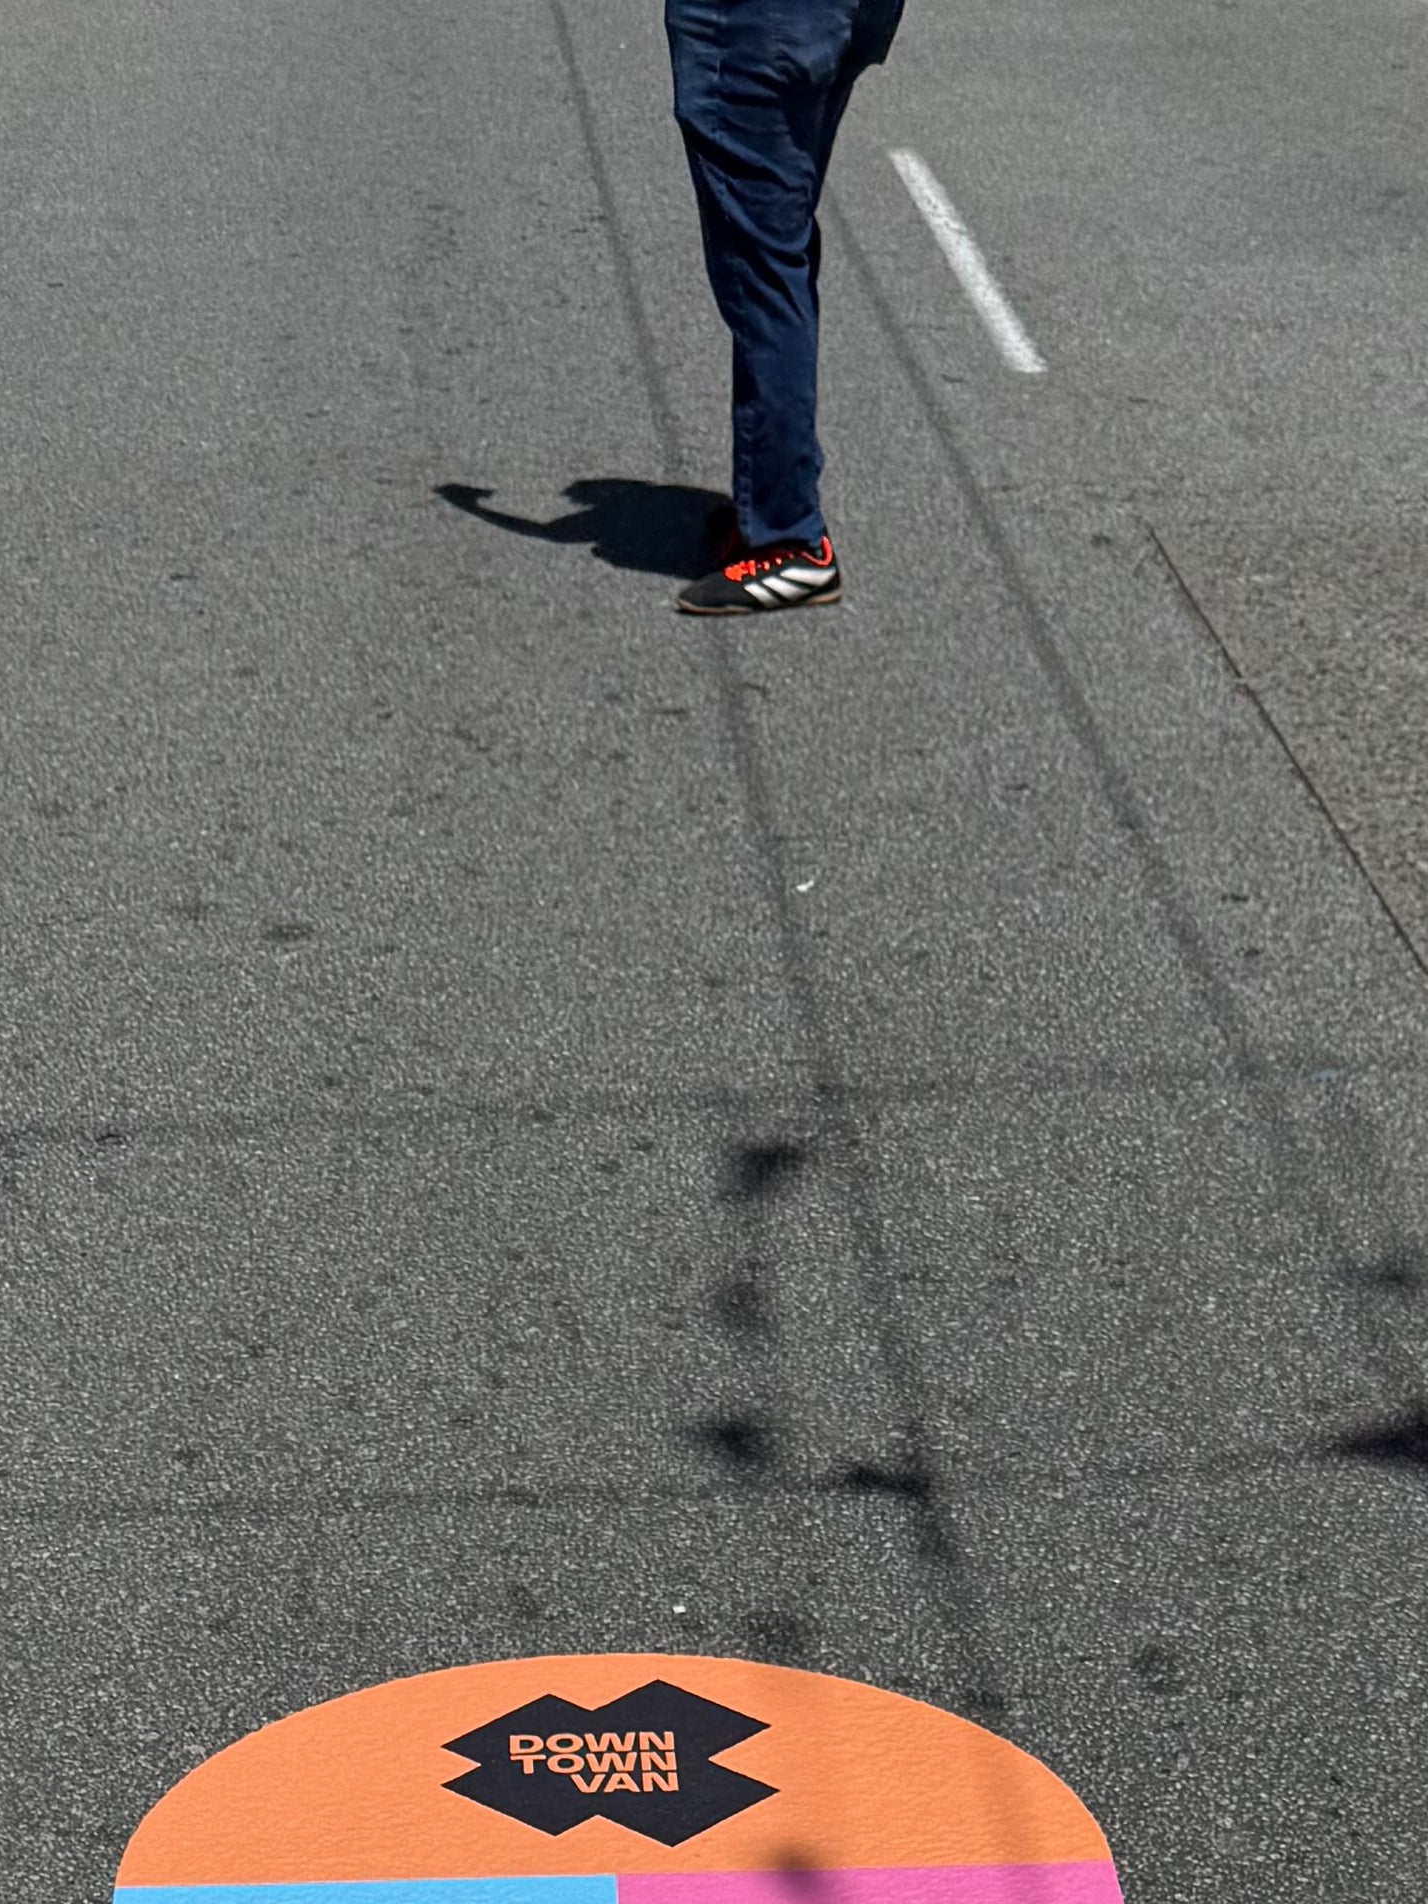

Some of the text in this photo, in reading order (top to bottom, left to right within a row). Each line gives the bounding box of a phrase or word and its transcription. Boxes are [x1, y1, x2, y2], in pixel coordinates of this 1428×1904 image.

[509, 1731, 675, 1753] DOWN
[510, 1752, 677, 1774] TOWN
[570, 1772, 679, 1793] VAN
